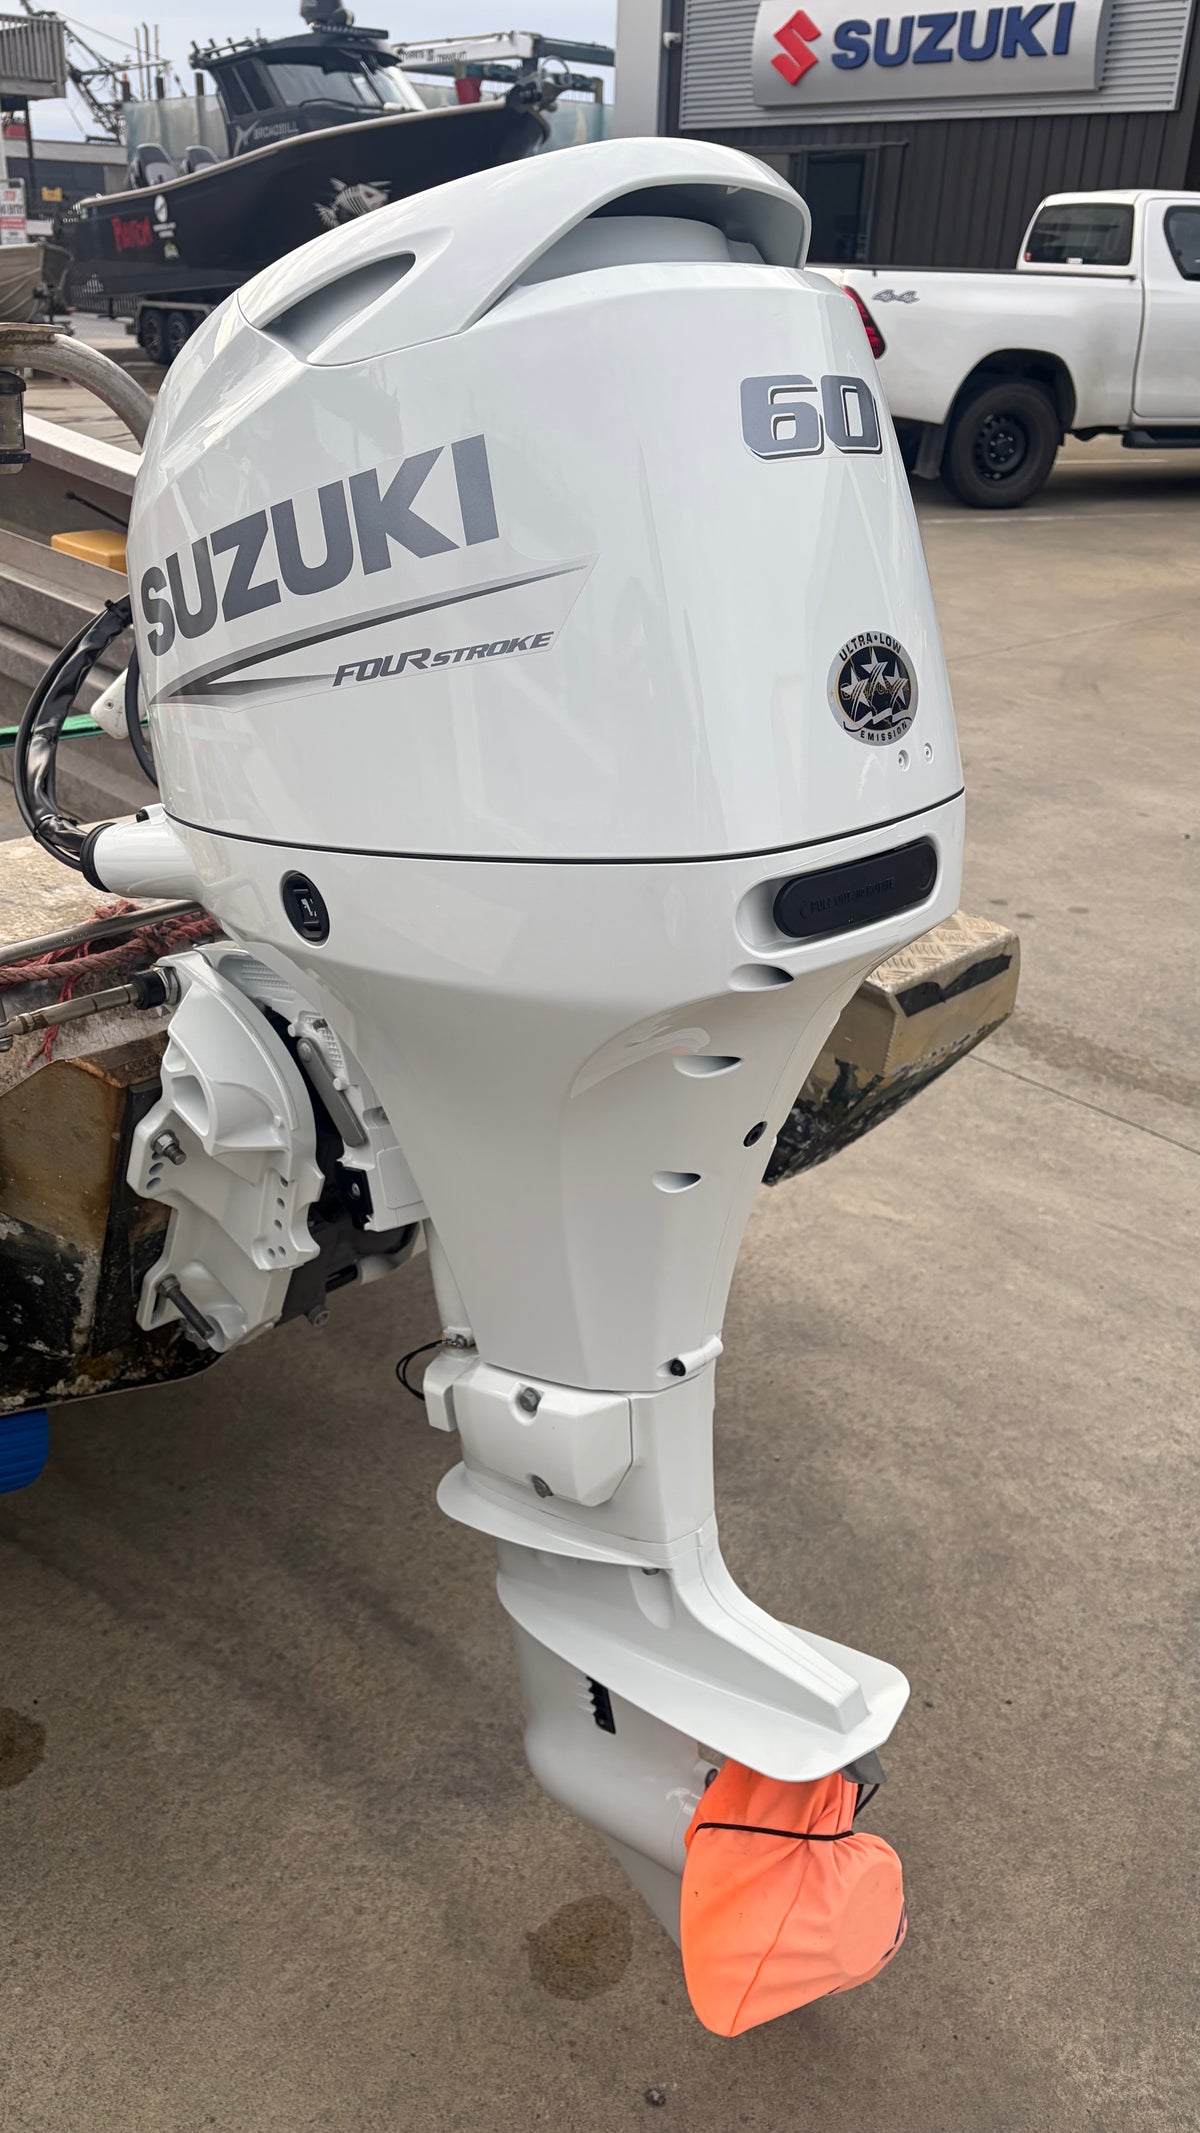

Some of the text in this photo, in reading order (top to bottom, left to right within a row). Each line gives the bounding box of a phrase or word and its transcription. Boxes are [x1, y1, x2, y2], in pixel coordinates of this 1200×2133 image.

[831, 1, 1075, 70] SUZUKI
[740, 375, 882, 460] 60
[140, 433, 500, 657] SUZUKI
[860, 721, 908, 742] EMISSION
